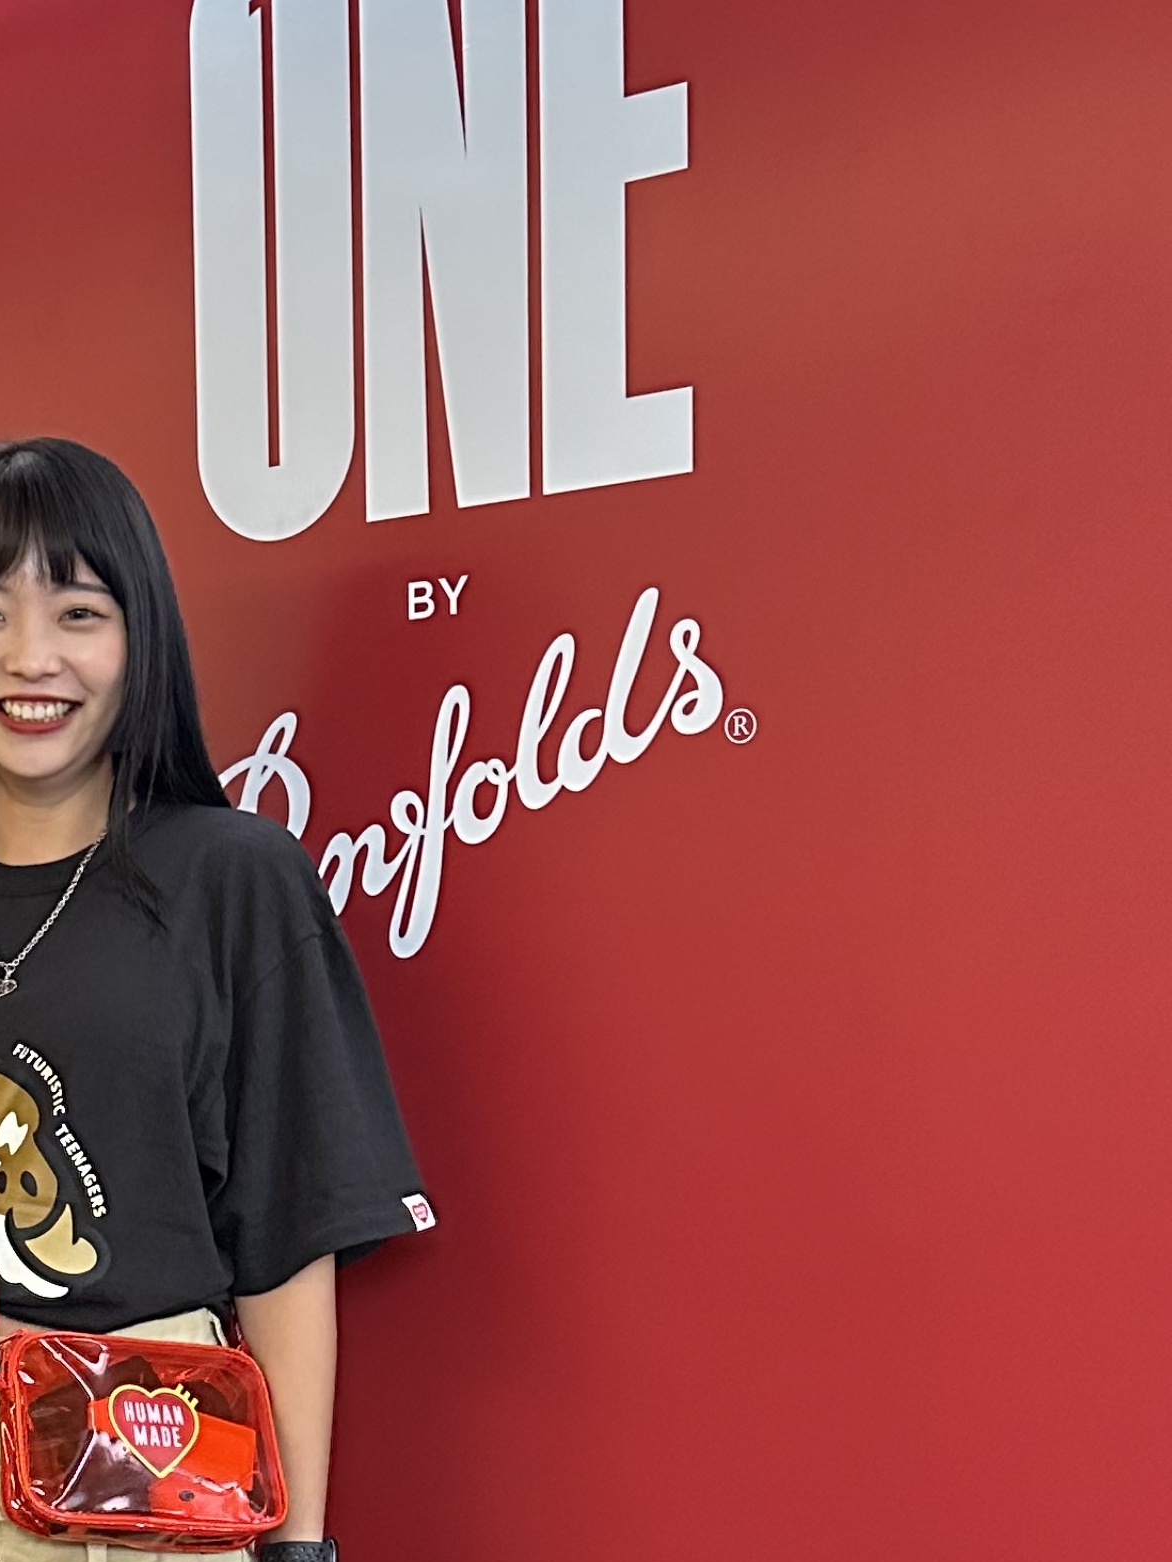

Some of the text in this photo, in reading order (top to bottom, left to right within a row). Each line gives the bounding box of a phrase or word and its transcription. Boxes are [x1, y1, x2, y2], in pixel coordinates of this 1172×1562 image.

[189, 0, 695, 542] ONE
[405, 575, 469, 621] BY
[12, 1042, 108, 1218] FUTURISTIC TEENAGERS
[123, 1400, 185, 1426] HUMAN
[132, 1424, 183, 1448] MADE
